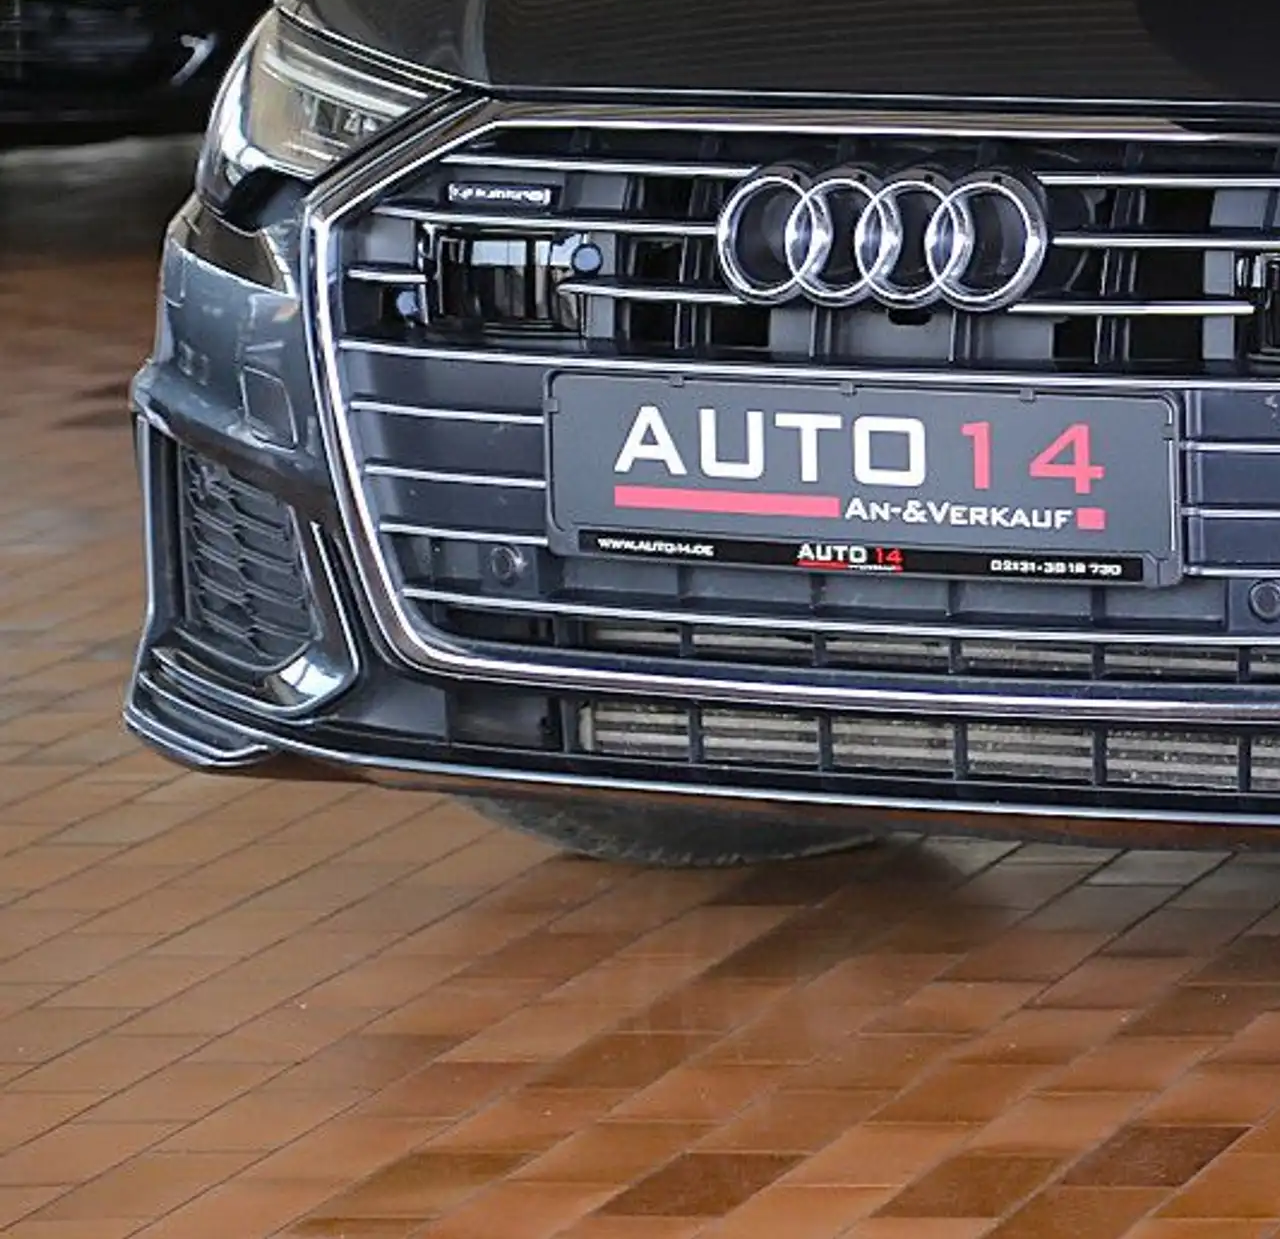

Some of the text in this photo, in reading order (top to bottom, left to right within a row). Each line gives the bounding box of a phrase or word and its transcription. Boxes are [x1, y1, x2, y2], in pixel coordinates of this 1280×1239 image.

[613, 405, 1106, 495] AUTO 14
[796, 542, 904, 565] AUTO 14
